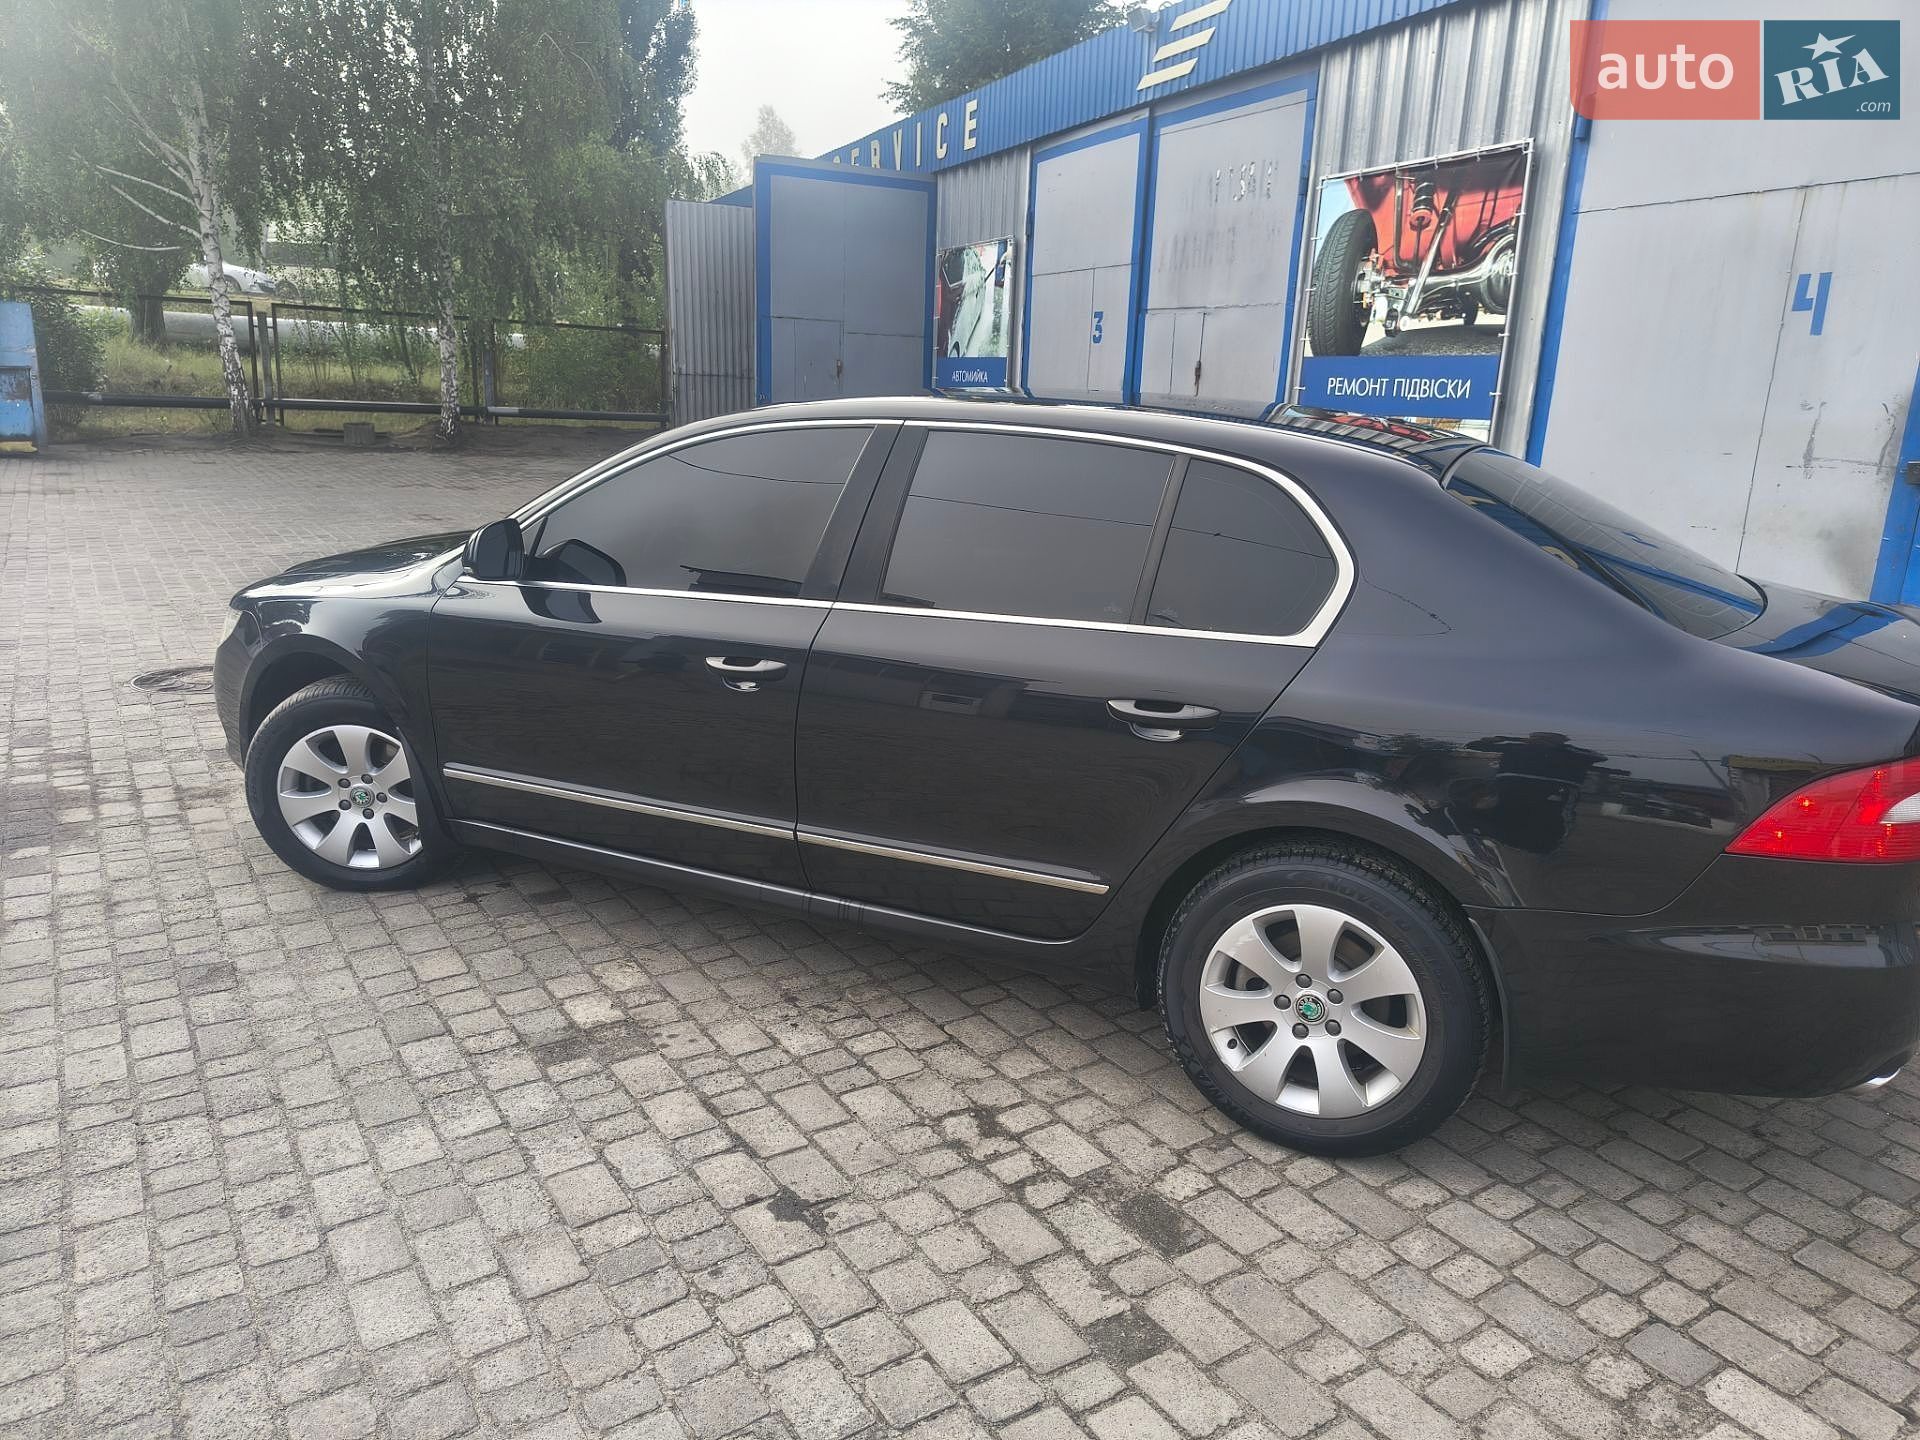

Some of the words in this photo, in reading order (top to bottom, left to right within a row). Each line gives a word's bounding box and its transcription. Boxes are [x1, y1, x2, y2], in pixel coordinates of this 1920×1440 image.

[832, 98, 979, 172] ERVICE
[1092, 311, 1104, 344] 3
[1791, 271, 1833, 337] 4
[1327, 377, 1389, 398] РЕМОНТ
[1393, 378, 1471, 401] ПІДВІСКИ
